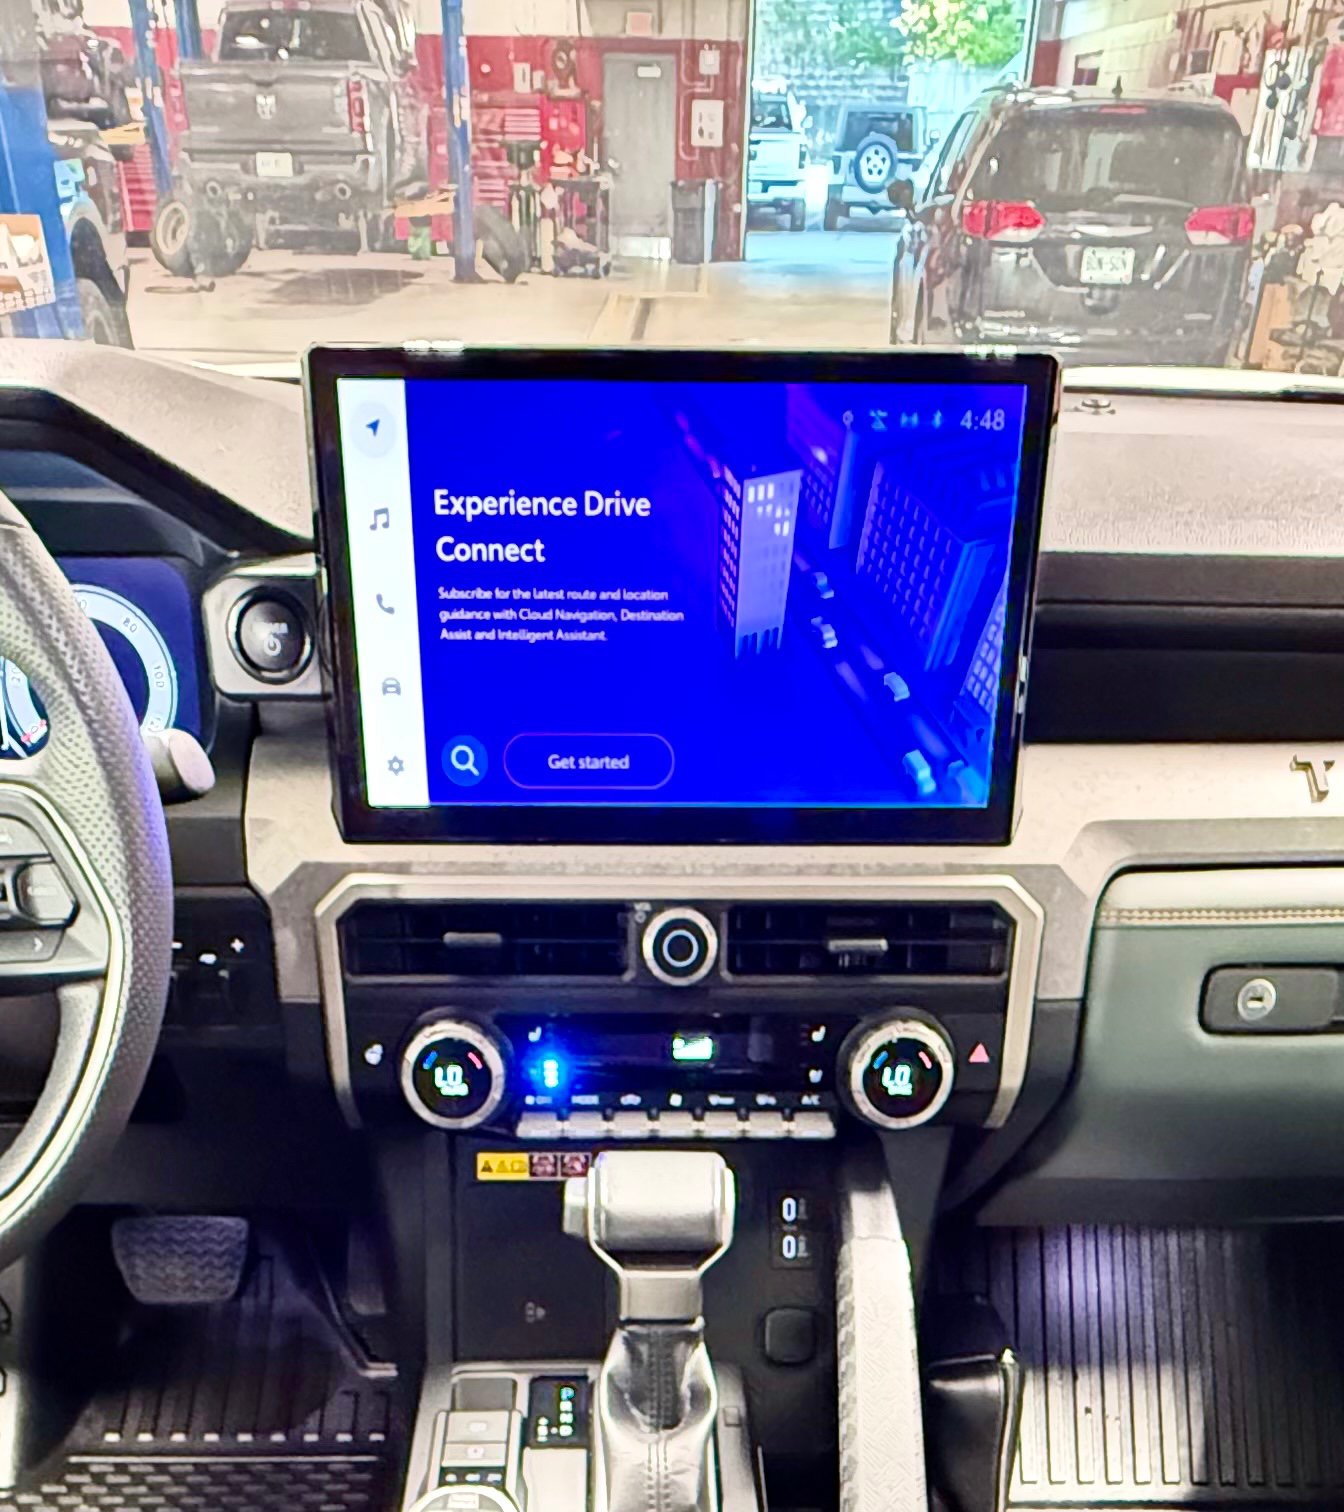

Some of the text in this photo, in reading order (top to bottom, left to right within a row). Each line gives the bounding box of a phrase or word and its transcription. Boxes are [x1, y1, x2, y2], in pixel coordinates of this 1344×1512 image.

[959, 408, 1005, 431] 4:48
[433, 488, 652, 523] Experience Drive
[435, 535, 546, 563] Connect
[437, 586, 669, 601] Subscribe for the latest route and location
[438, 608, 685, 623] guidance with Cloud Navigation, Destination
[122, 617, 138, 634] 80
[440, 628, 473, 641] Assist
[474, 629, 496, 640] and
[497, 628, 555, 644] Intelligent
[547, 753, 631, 770] Get started
[560, 1386, 575, 1401] P
